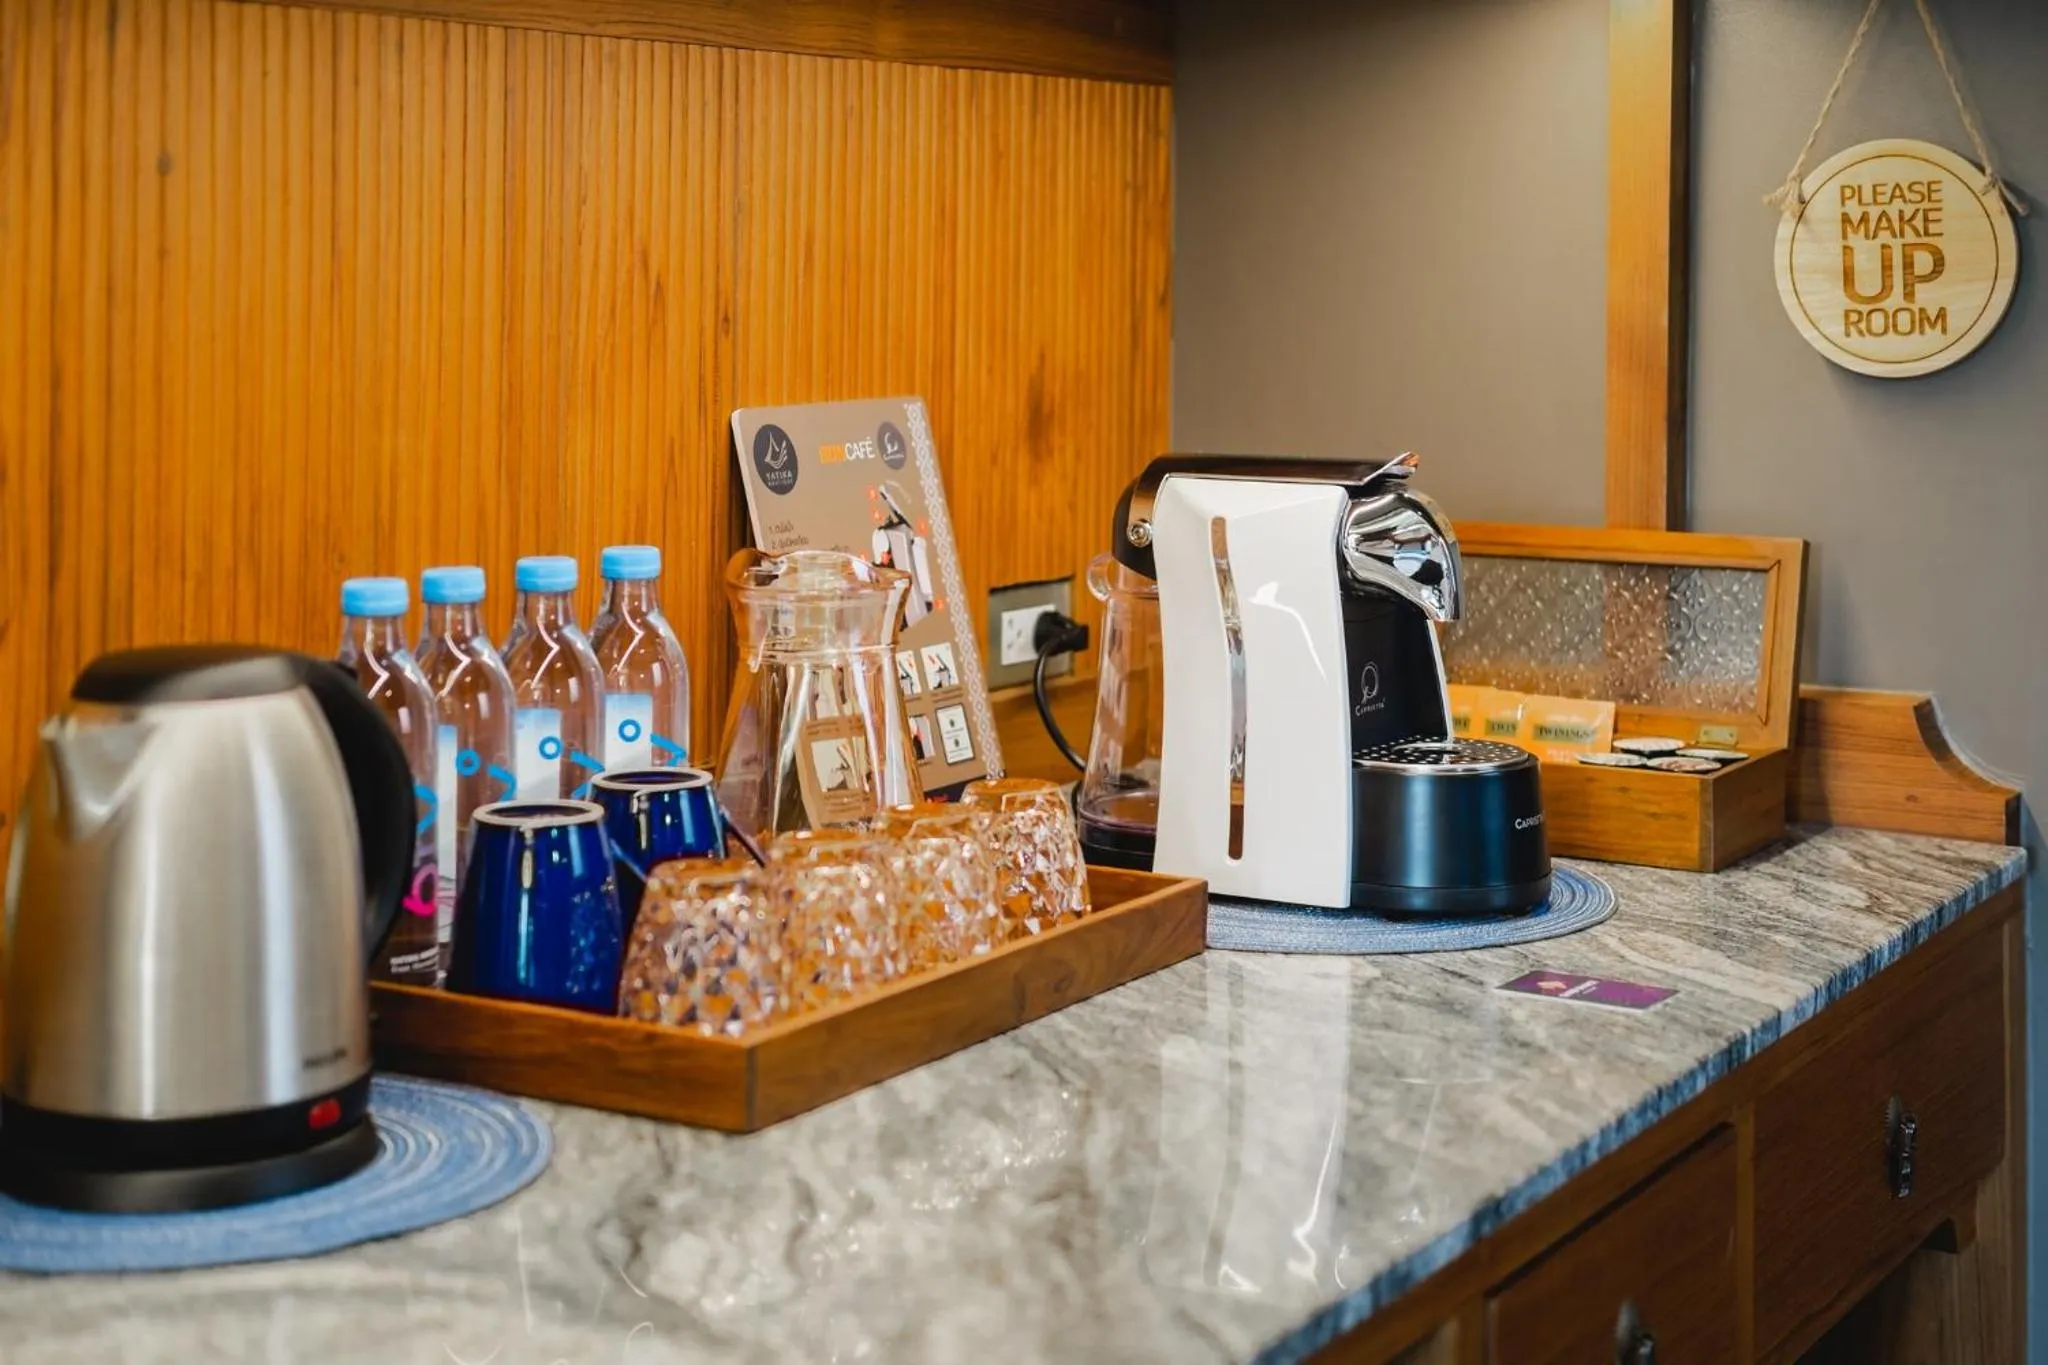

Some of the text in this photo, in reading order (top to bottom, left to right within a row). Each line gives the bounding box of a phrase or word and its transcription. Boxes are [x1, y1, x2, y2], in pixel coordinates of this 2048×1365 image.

[1840, 180, 1943, 207] PLEASE
[1841, 207, 1944, 240] MAKE
[1842, 242, 1945, 305] UP
[1844, 306, 1948, 338] ROOM
[819, 437, 876, 464] CAFÉ
[1539, 723, 1590, 739] TWININGS
